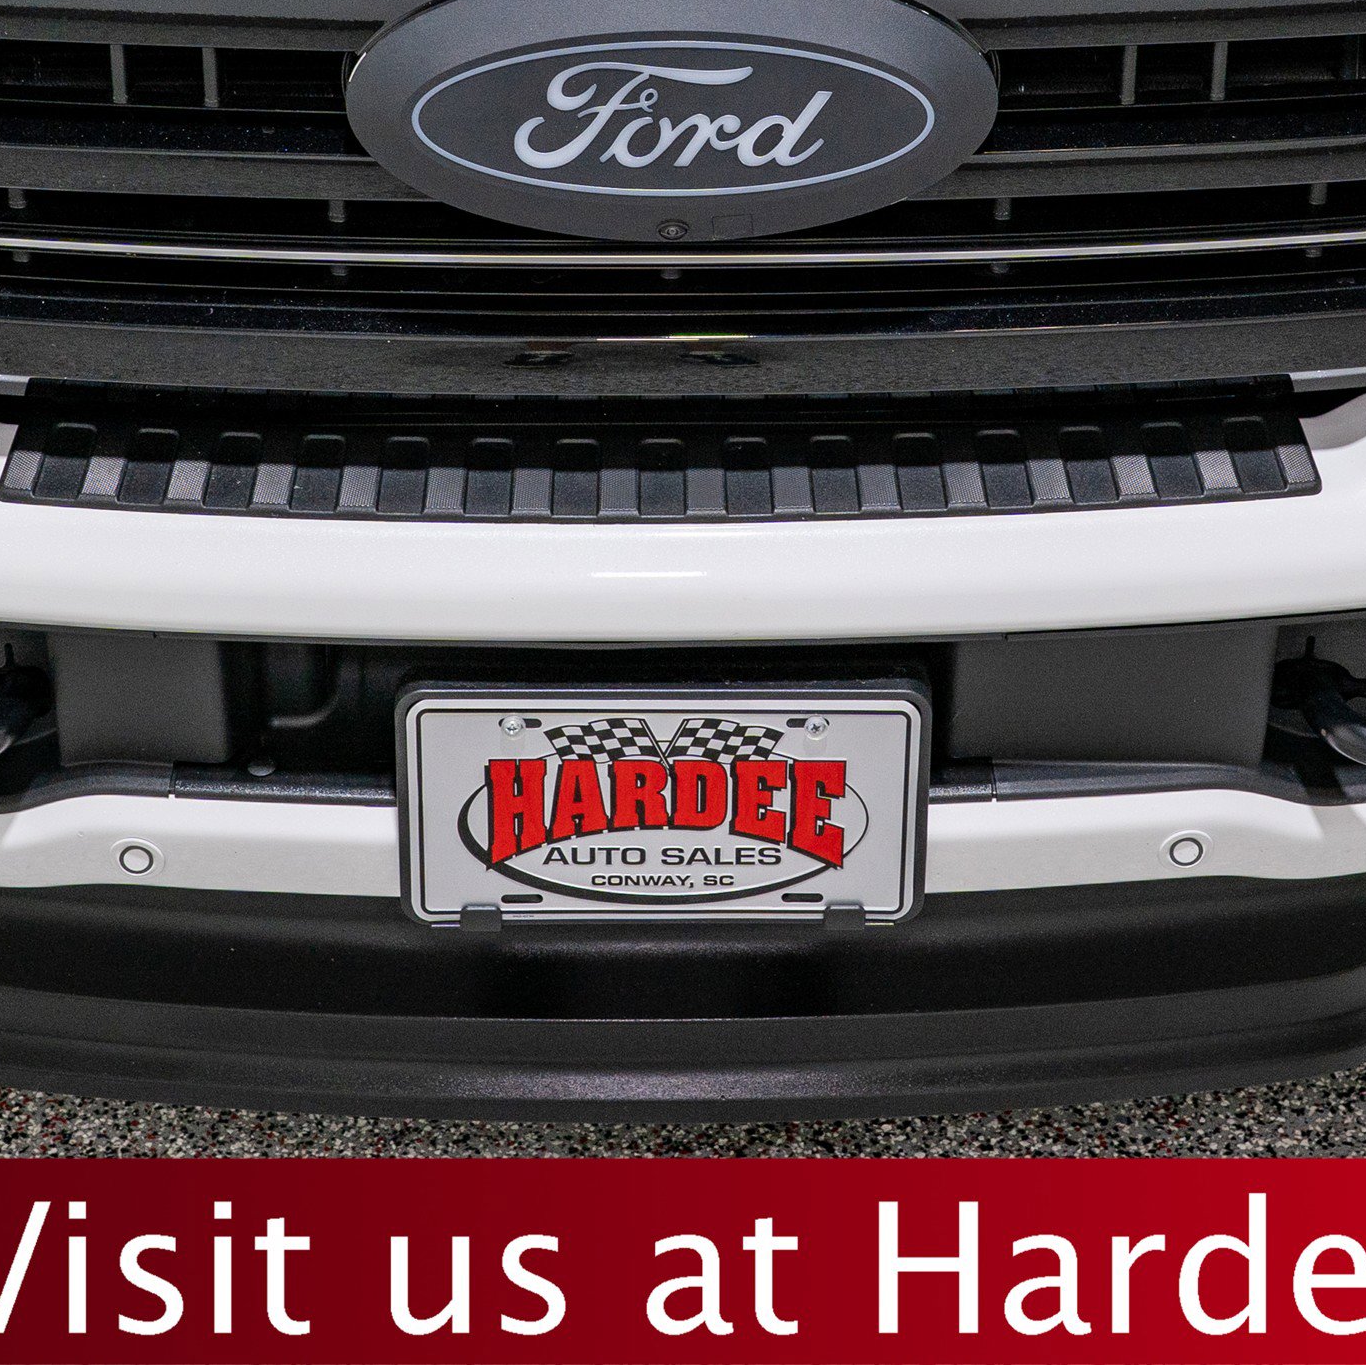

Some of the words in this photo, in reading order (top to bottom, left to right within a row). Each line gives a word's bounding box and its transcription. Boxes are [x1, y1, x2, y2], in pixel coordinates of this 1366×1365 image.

[513, 61, 833, 169] Ford
[484, 757, 848, 870] HARDEE
[542, 846, 647, 866] AUTO
[660, 846, 783, 866] SALES
[591, 874, 695, 889] CONWAY,
[702, 874, 735, 887] SC
